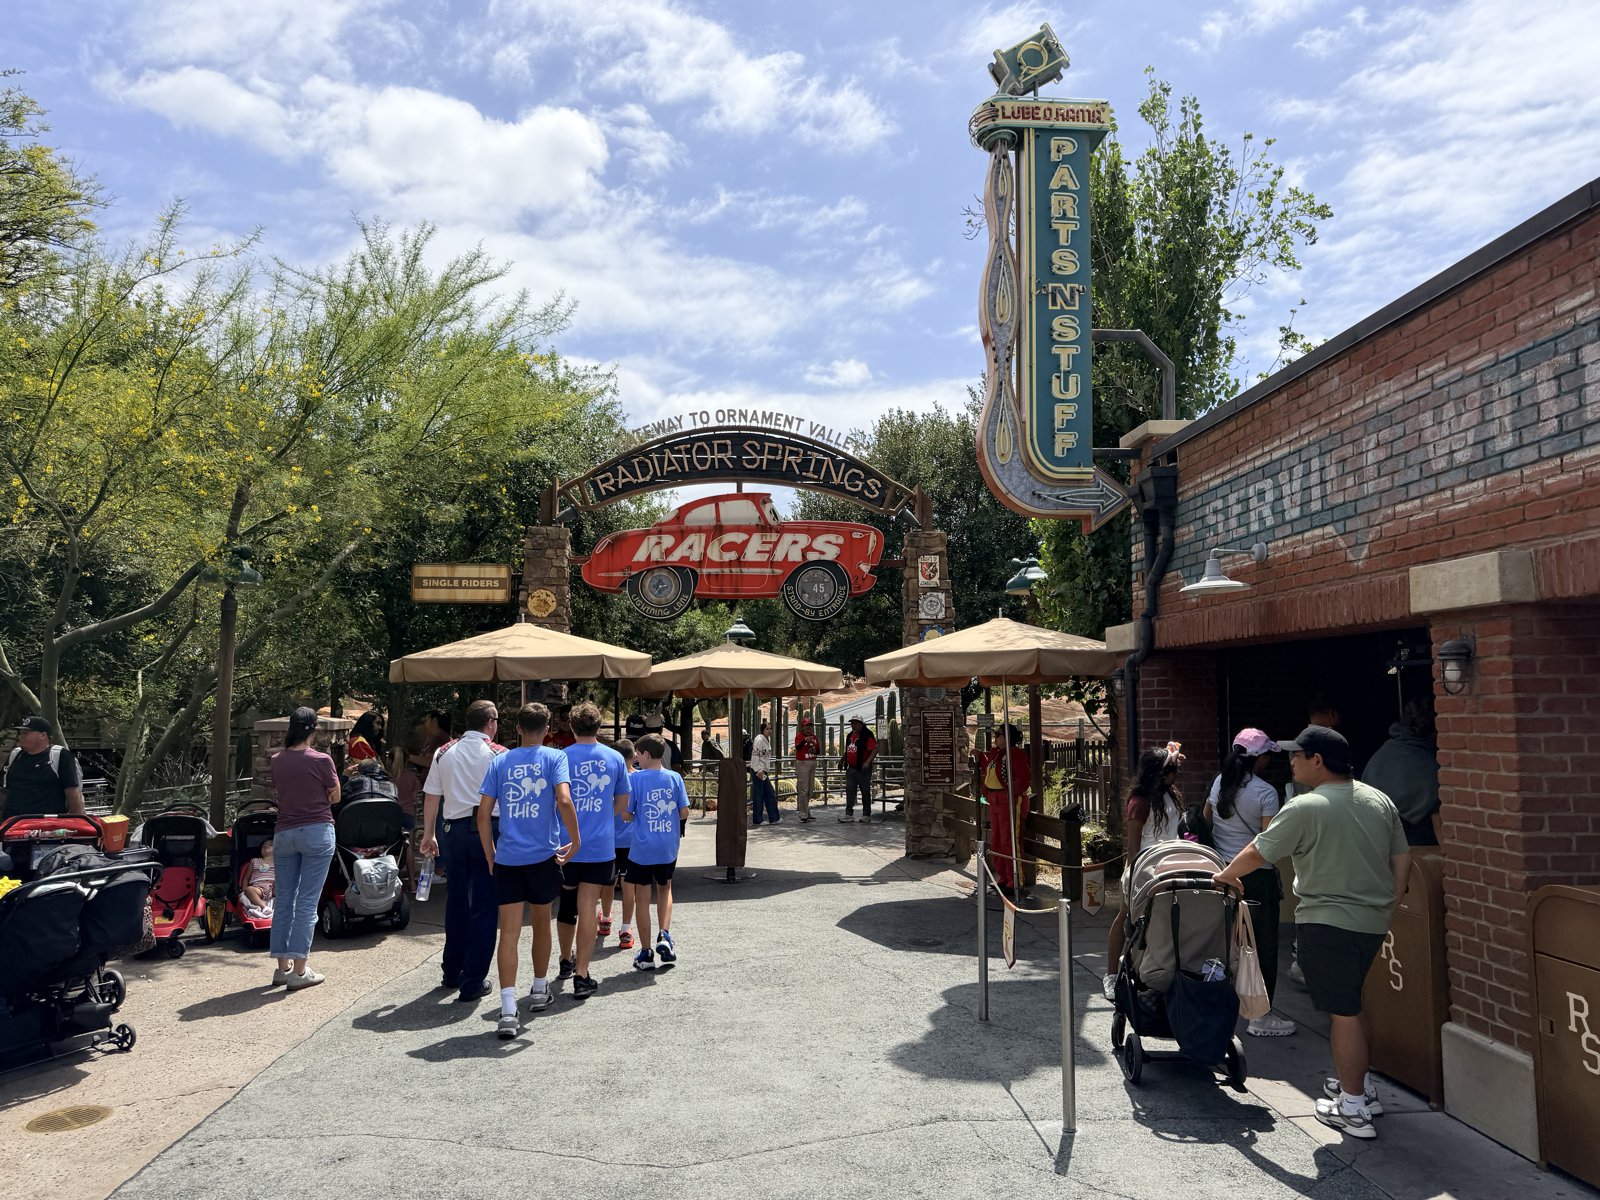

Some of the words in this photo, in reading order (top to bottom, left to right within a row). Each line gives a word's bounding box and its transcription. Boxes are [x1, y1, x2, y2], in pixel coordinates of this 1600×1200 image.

[1049, 137, 1080, 275] PARTS
[1052, 315, 1080, 458] STUFF
[689, 411, 710, 427] TO
[715, 409, 804, 431] ORNAMENT
[809, 421, 858, 450] VALLE
[594, 440, 733, 496] RADIATOR
[742, 440, 882, 499] SPRINGS
[632, 532, 845, 562] RACERS
[422, 579, 460, 587] SINGLE
[461, 579, 500, 587] RIDERS
[812, 583, 825, 593] 45
[631, 593, 670, 616] LIGHTNING
[673, 593, 689, 611] LANE
[819, 585, 846, 617] ENTRANCE
